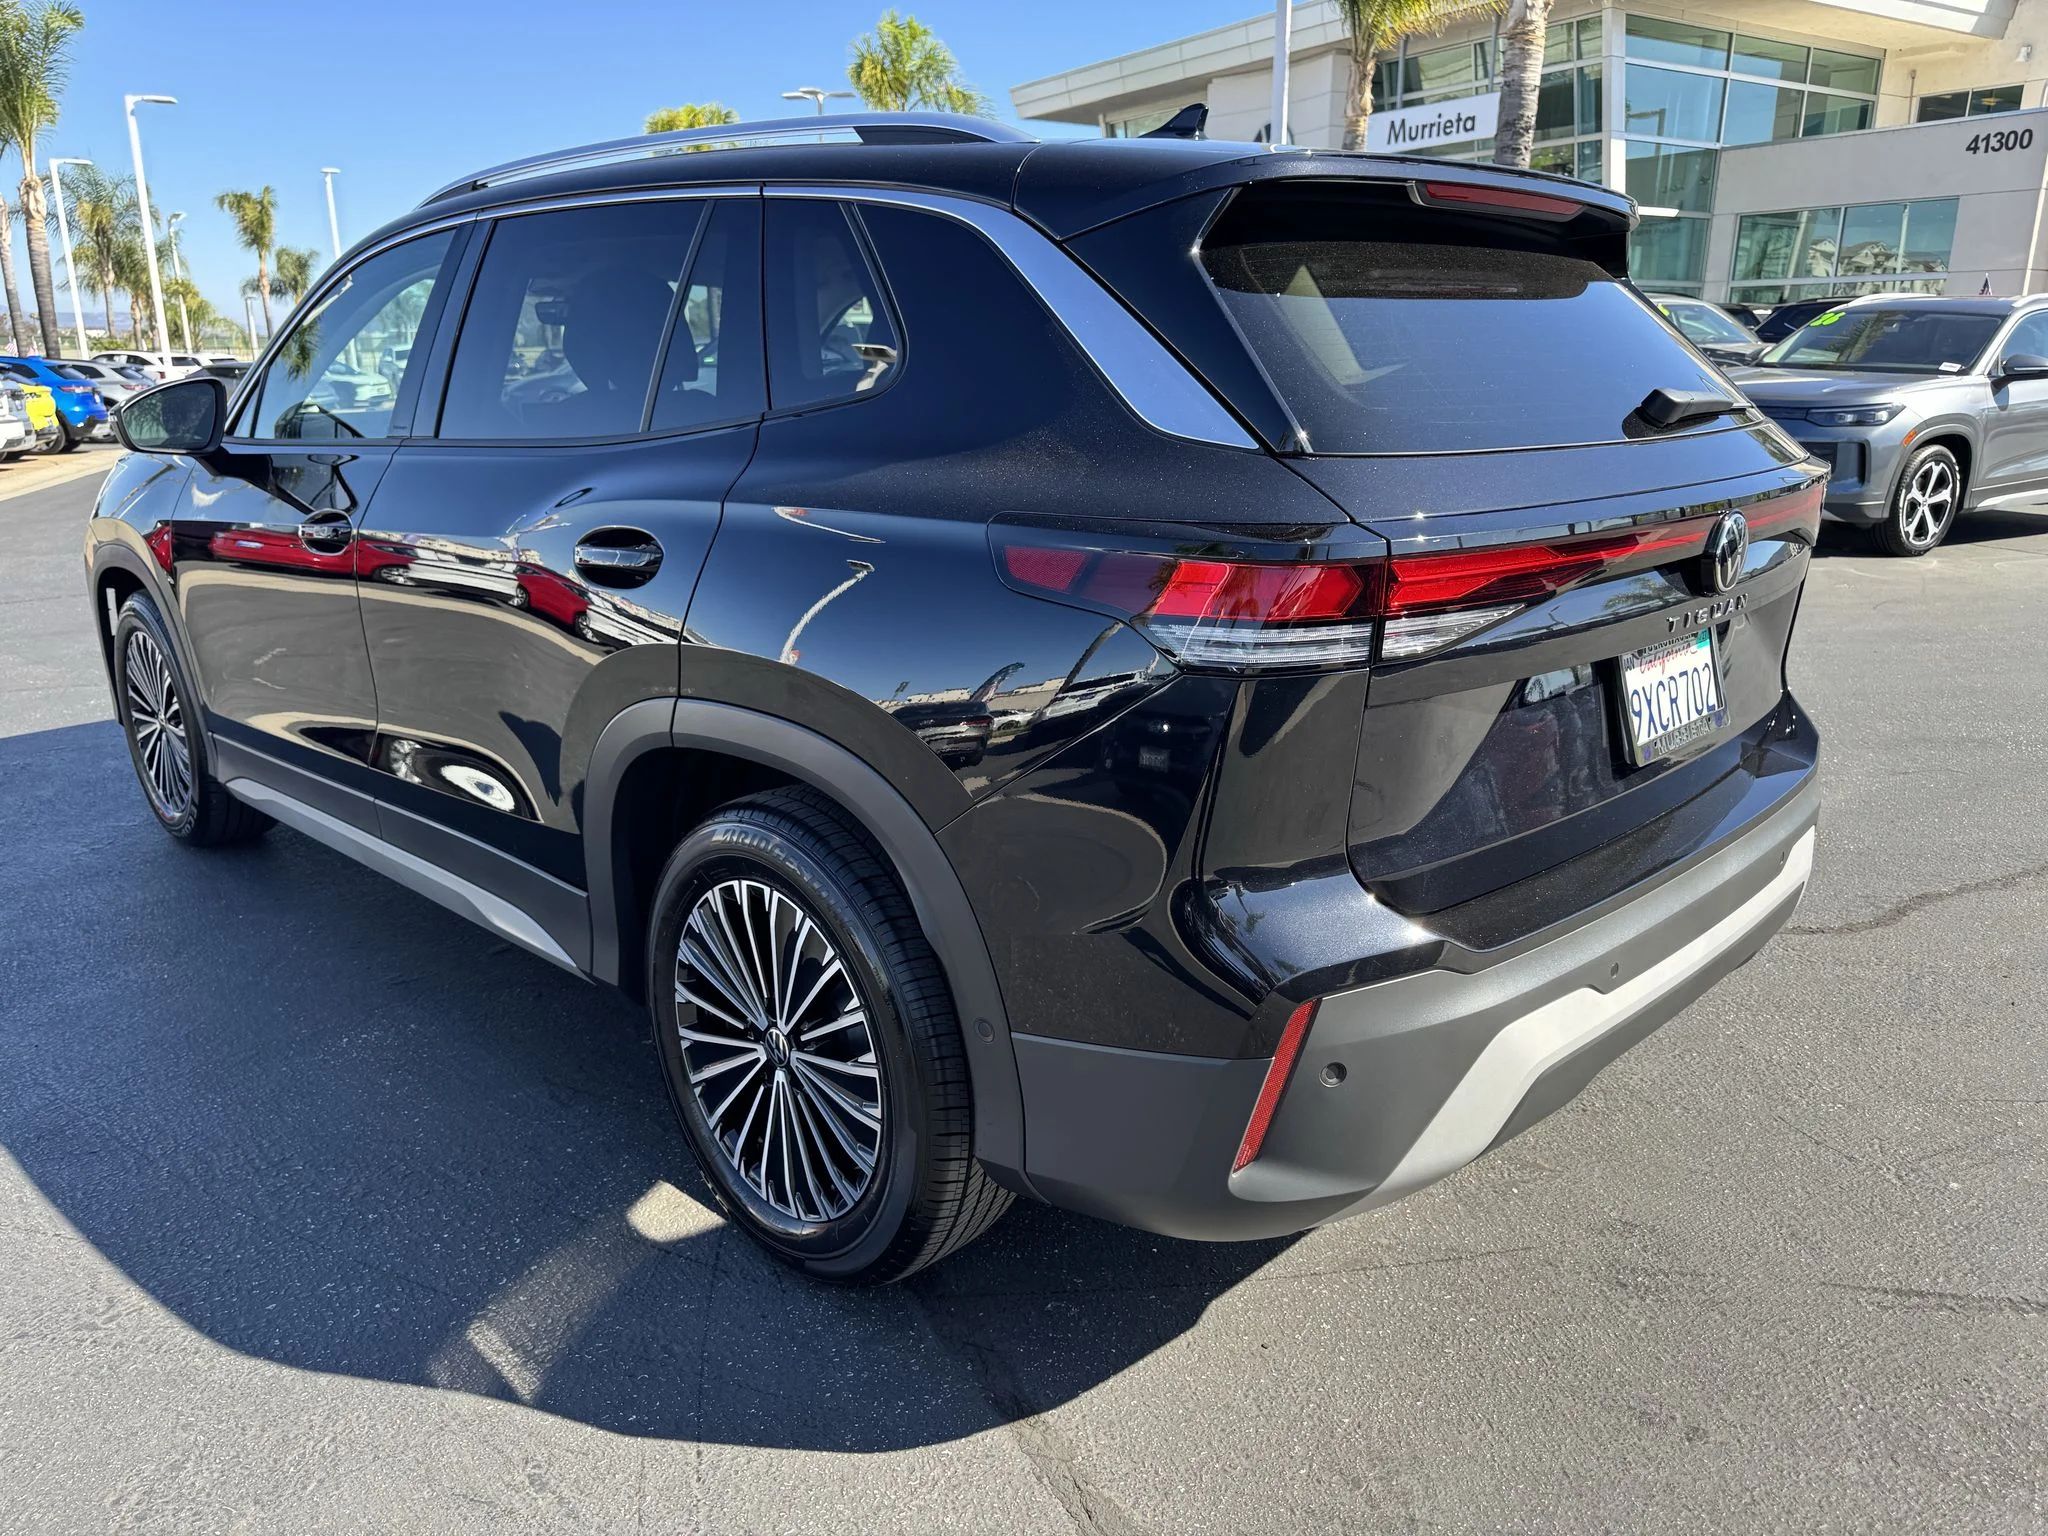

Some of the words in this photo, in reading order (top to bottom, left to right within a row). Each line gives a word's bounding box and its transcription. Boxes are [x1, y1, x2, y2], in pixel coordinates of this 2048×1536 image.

[1387, 112, 1476, 145] Murrieta
[1965, 128, 2033, 155] 41300
[1666, 593, 1749, 633] TIGUAN
[1640, 642, 1698, 675] California
[1630, 662, 1716, 744] 9XCR702
